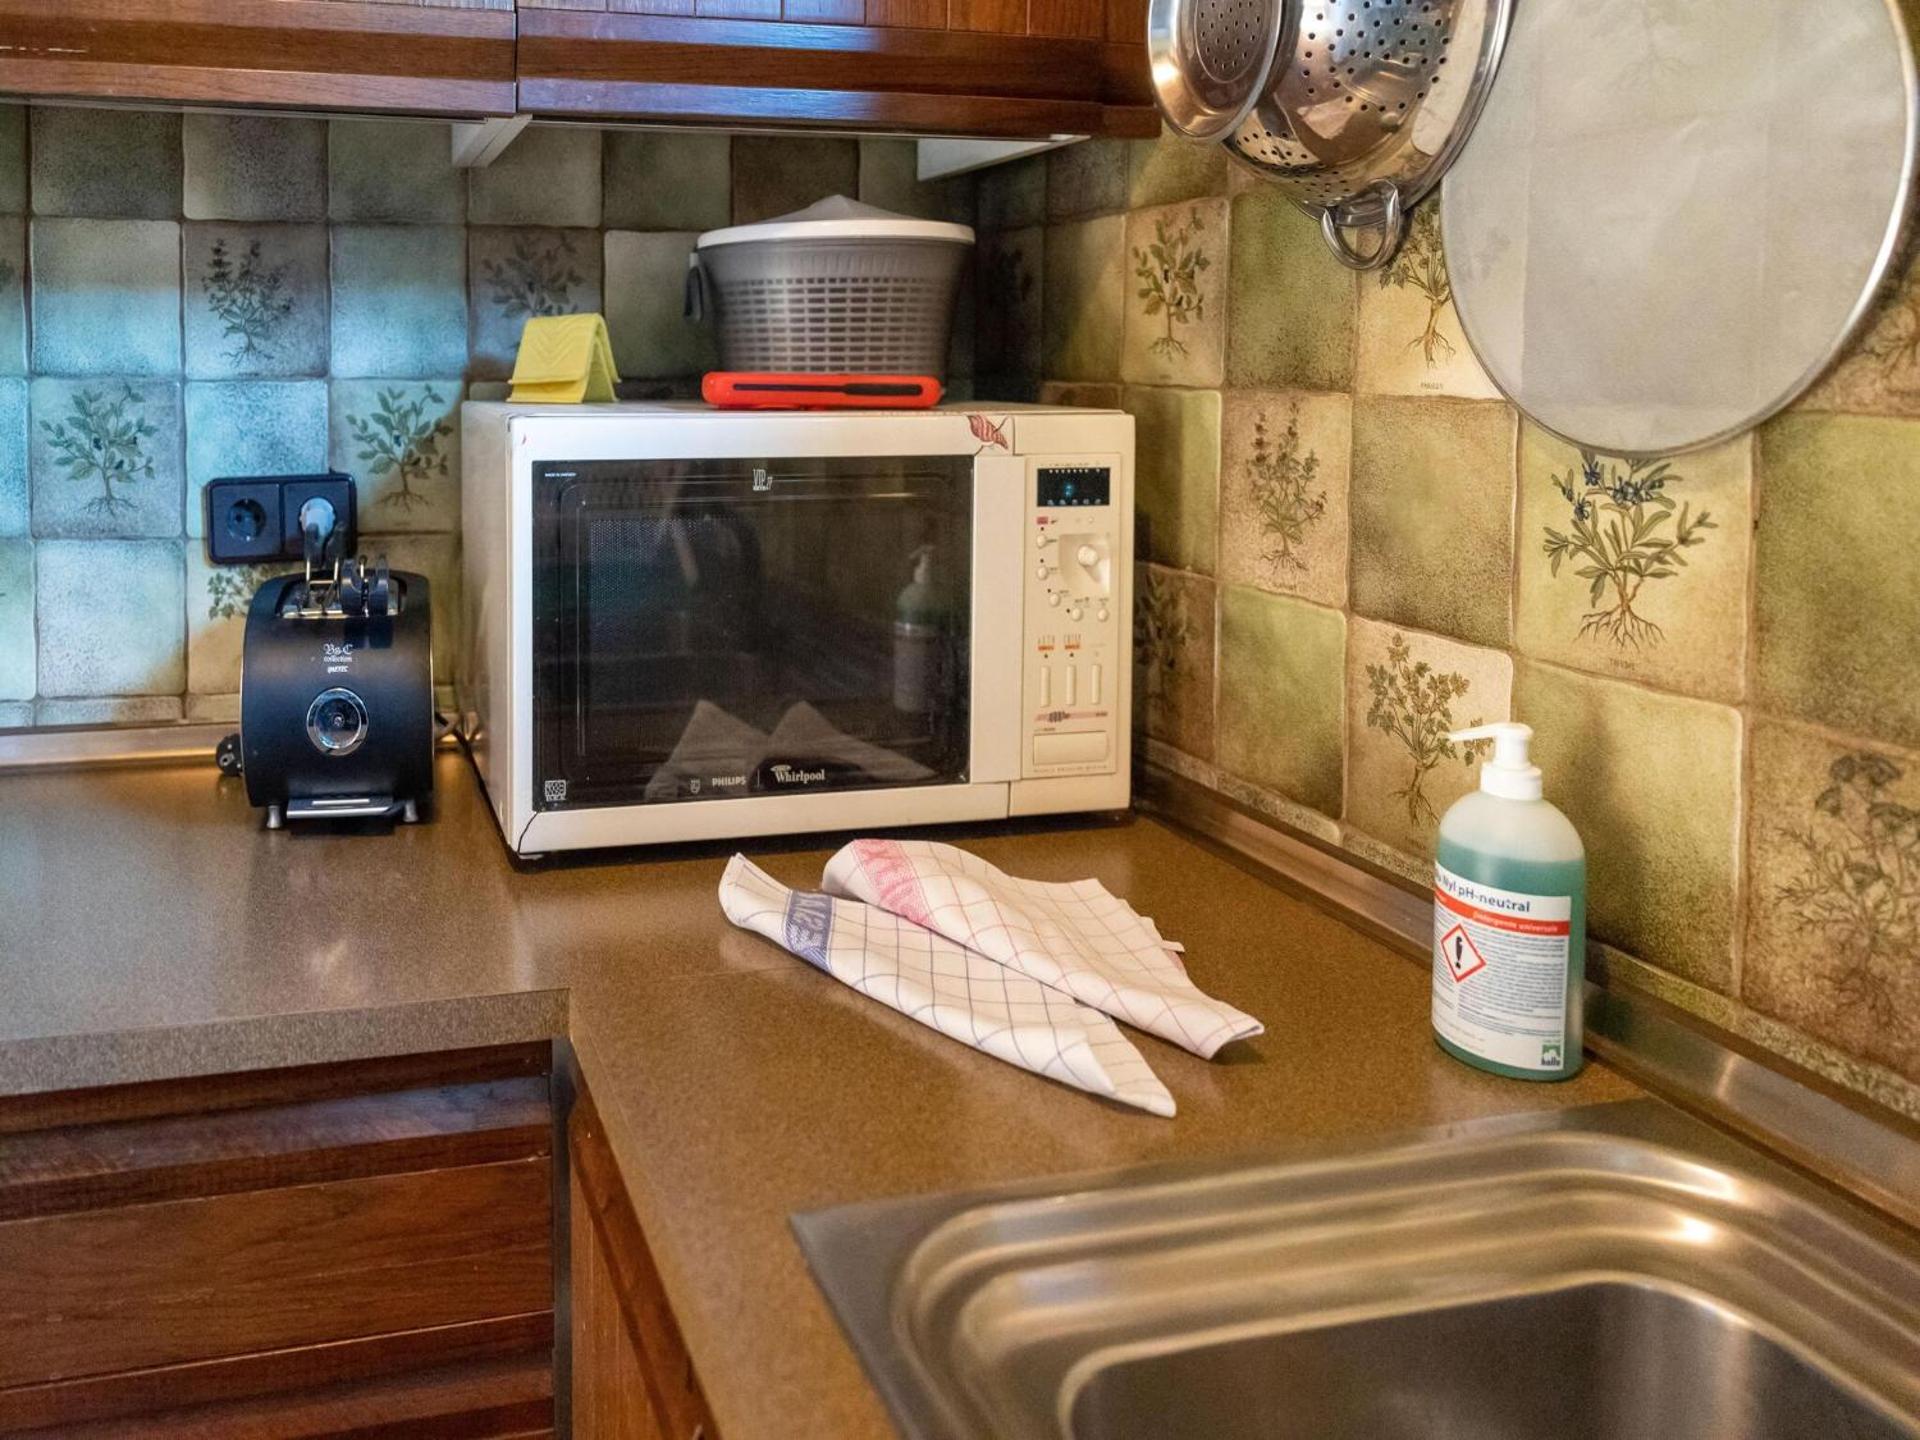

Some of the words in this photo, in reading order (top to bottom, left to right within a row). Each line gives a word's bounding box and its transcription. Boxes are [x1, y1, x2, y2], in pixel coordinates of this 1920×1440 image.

[711, 776, 746, 787] PHILIPS
[773, 769, 825, 784] Whirlpool
[1458, 888, 1531, 912] pH-neutral
